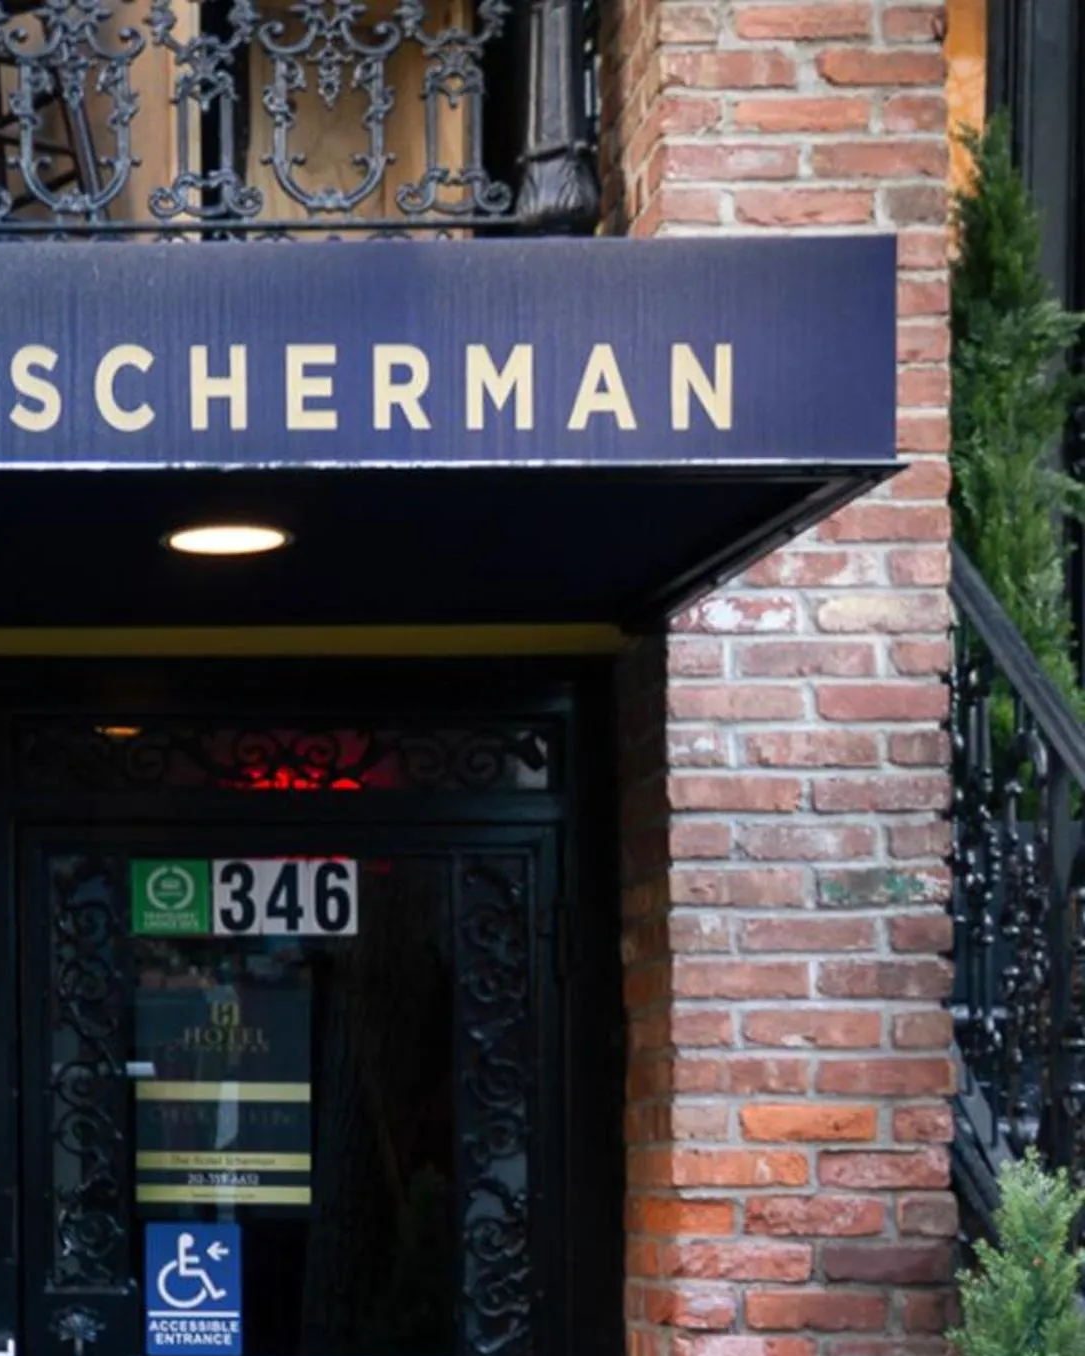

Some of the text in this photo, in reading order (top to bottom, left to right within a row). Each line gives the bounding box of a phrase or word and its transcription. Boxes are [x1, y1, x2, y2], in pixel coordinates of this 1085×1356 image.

[9, 343, 733, 432] SCHERMAN
[219, 862, 351, 933] 346
[148, 1319, 240, 1333] ACCESSIBLE
[154, 1332, 233, 1346] ENTRANCE
